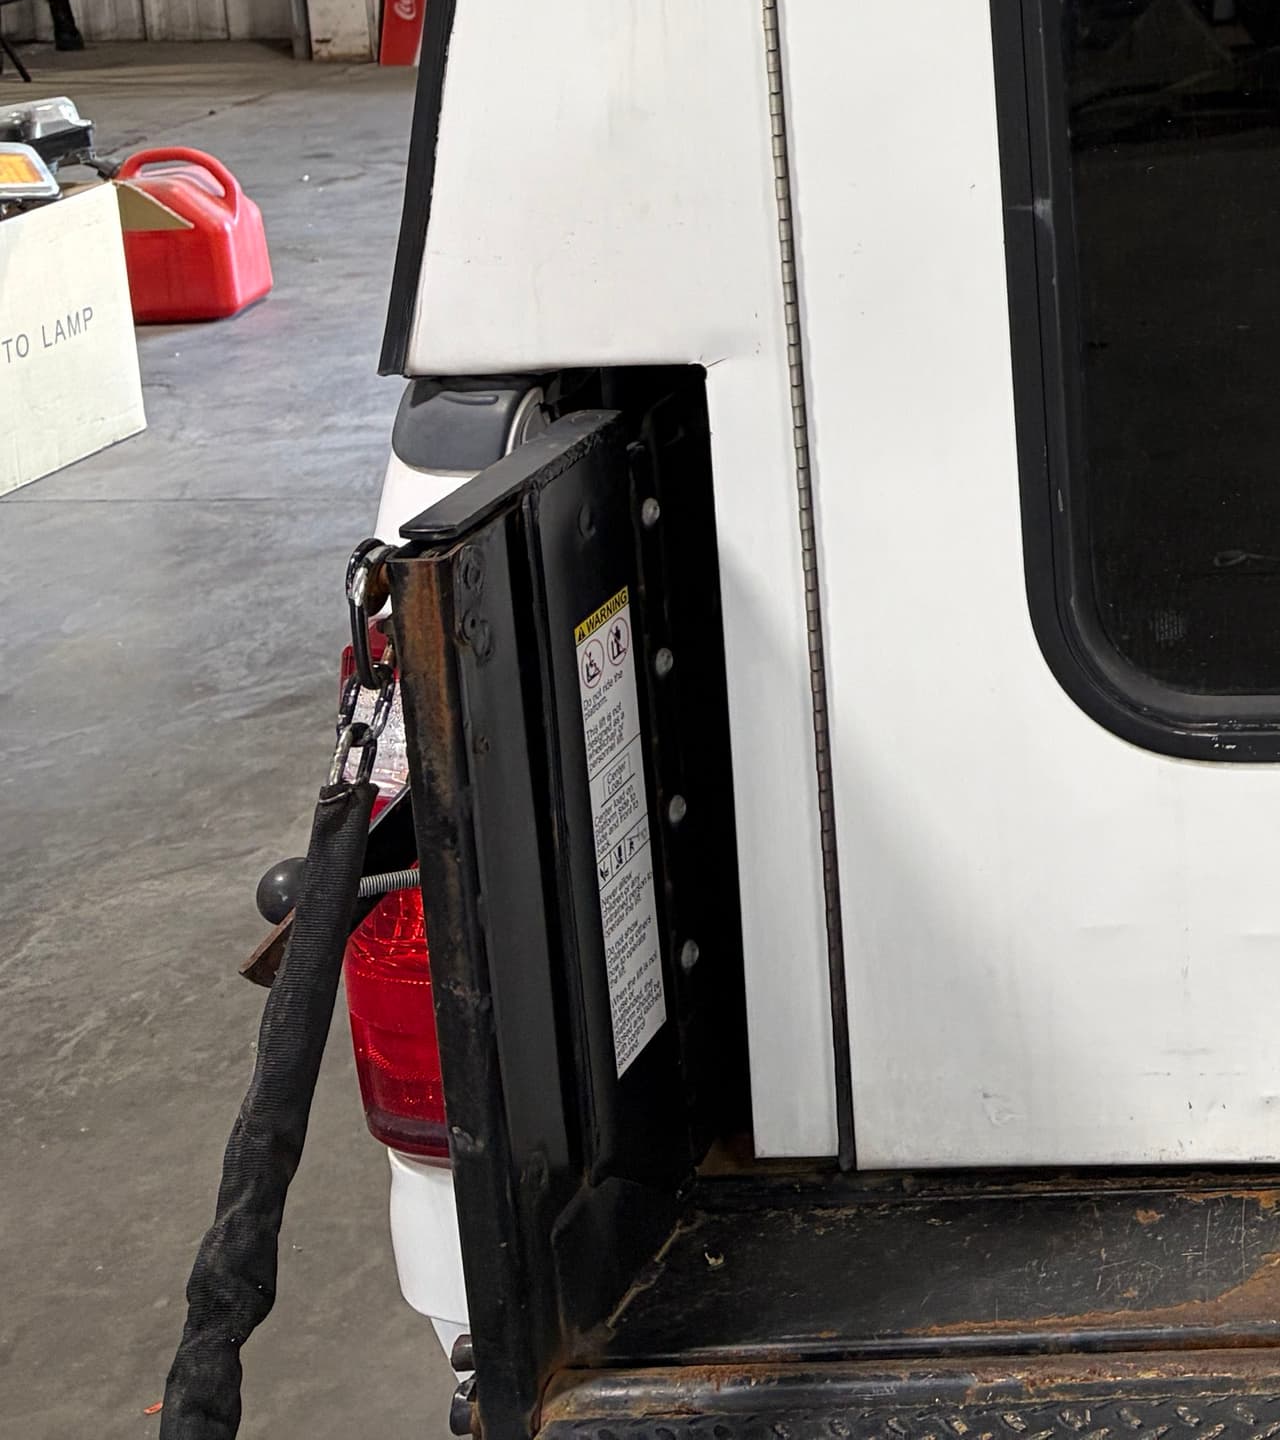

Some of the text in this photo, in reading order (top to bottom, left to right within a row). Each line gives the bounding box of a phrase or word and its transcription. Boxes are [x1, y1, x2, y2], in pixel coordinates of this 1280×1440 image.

[41, 306, 94, 348] LAMP
[586, 589, 628, 632] WARNING
[607, 761, 625, 784] Center
[608, 773, 622, 795] Load
